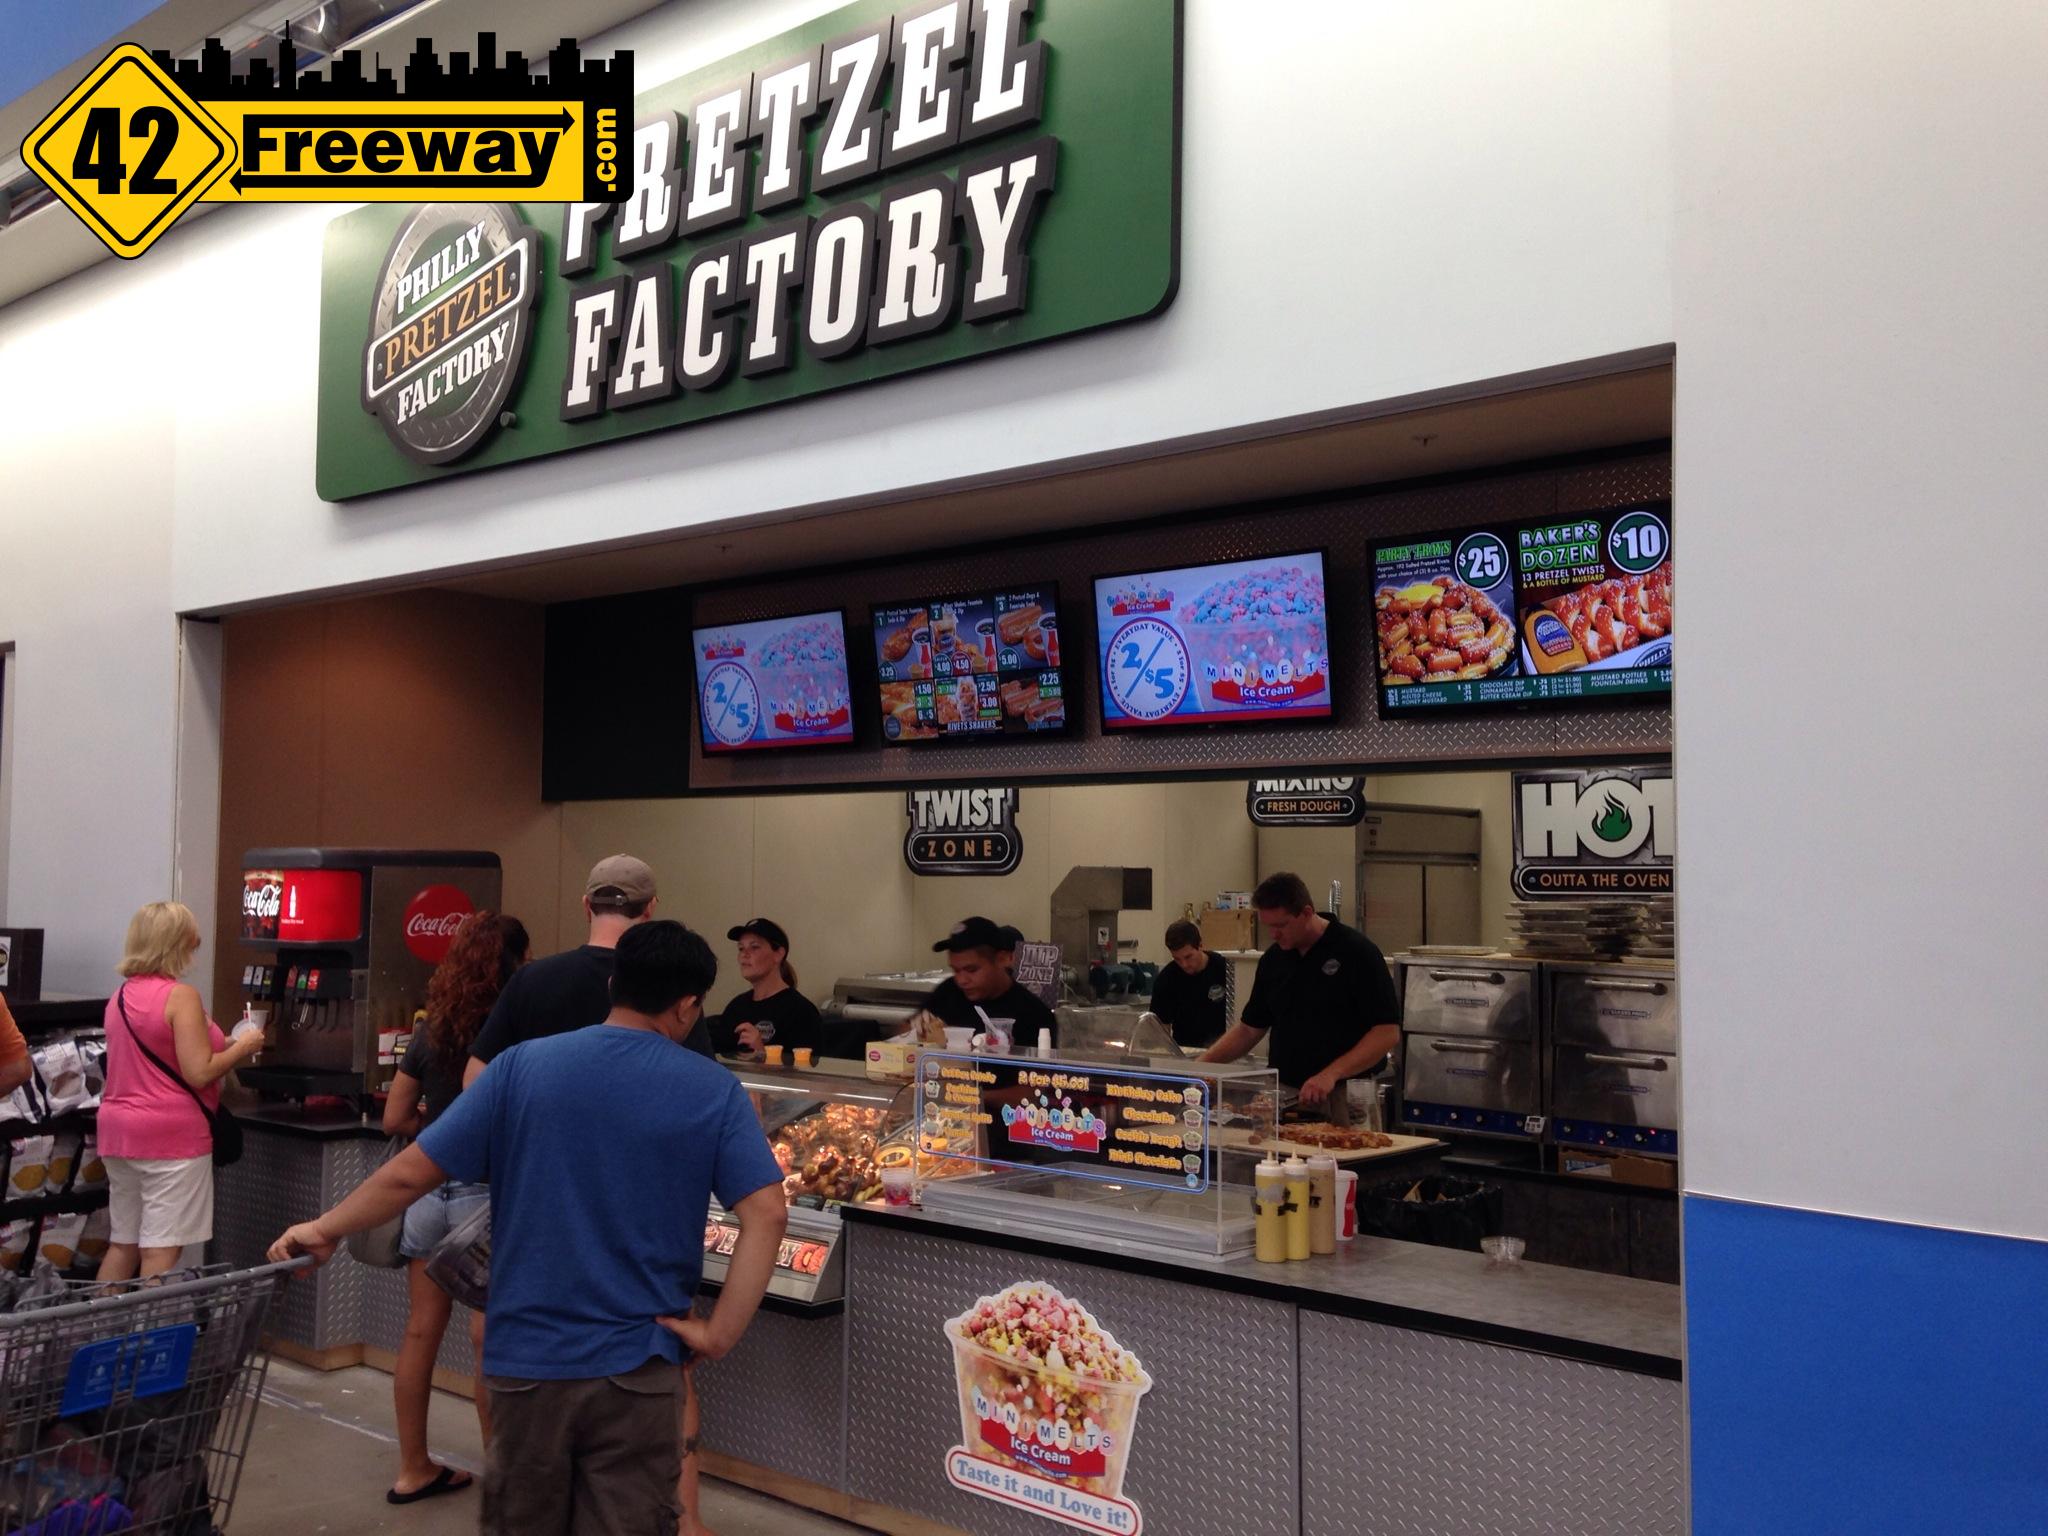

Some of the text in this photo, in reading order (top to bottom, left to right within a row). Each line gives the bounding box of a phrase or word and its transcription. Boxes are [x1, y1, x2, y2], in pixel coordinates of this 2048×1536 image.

[396, 220, 486, 315] PHILLY
[567, 155, 1037, 407] FACTORY
[385, 262, 512, 379] PRETZEL
[397, 321, 511, 425] FACTORY
[1520, 523, 1598, 548] BAKER'S
[1613, 524, 1661, 560] $10
[1459, 545, 1501, 578] $25
[1522, 544, 1596, 568] DOZEN
[1522, 565, 1605, 582] 13 PRETZEL TWISTS
[1536, 579, 1558, 587] BOTTLE
[1561, 577, 1570, 585] OF
[1572, 574, 1605, 584] MUSTARD
[1115, 623, 1149, 649] EVERYDAY
[1151, 624, 1175, 643] VALUE
[1207, 659, 1328, 681] MINI MELTS
[1240, 685, 1295, 697] Ice Cream
[1480, 681, 1513, 689] CHOCOLATE
[805, 717, 829, 727] Cream
[914, 789, 1005, 827] TWIST
[1267, 800, 1340, 812] FRESH DOUGH
[927, 839, 992, 857] ZONE
[1540, 873, 1669, 887] OUTTA THE OVEN
[407, 912, 472, 936] Coca-Col
[1005, 1105, 1104, 1136] MINI MELTS
[1032, 1127, 1074, 1141] Ice Cream
[976, 1396, 1111, 1449] MINI MELTS
[1010, 1436, 1071, 1465] Ice Cream
[957, 1459, 1128, 1530] Taste it and Love it!
